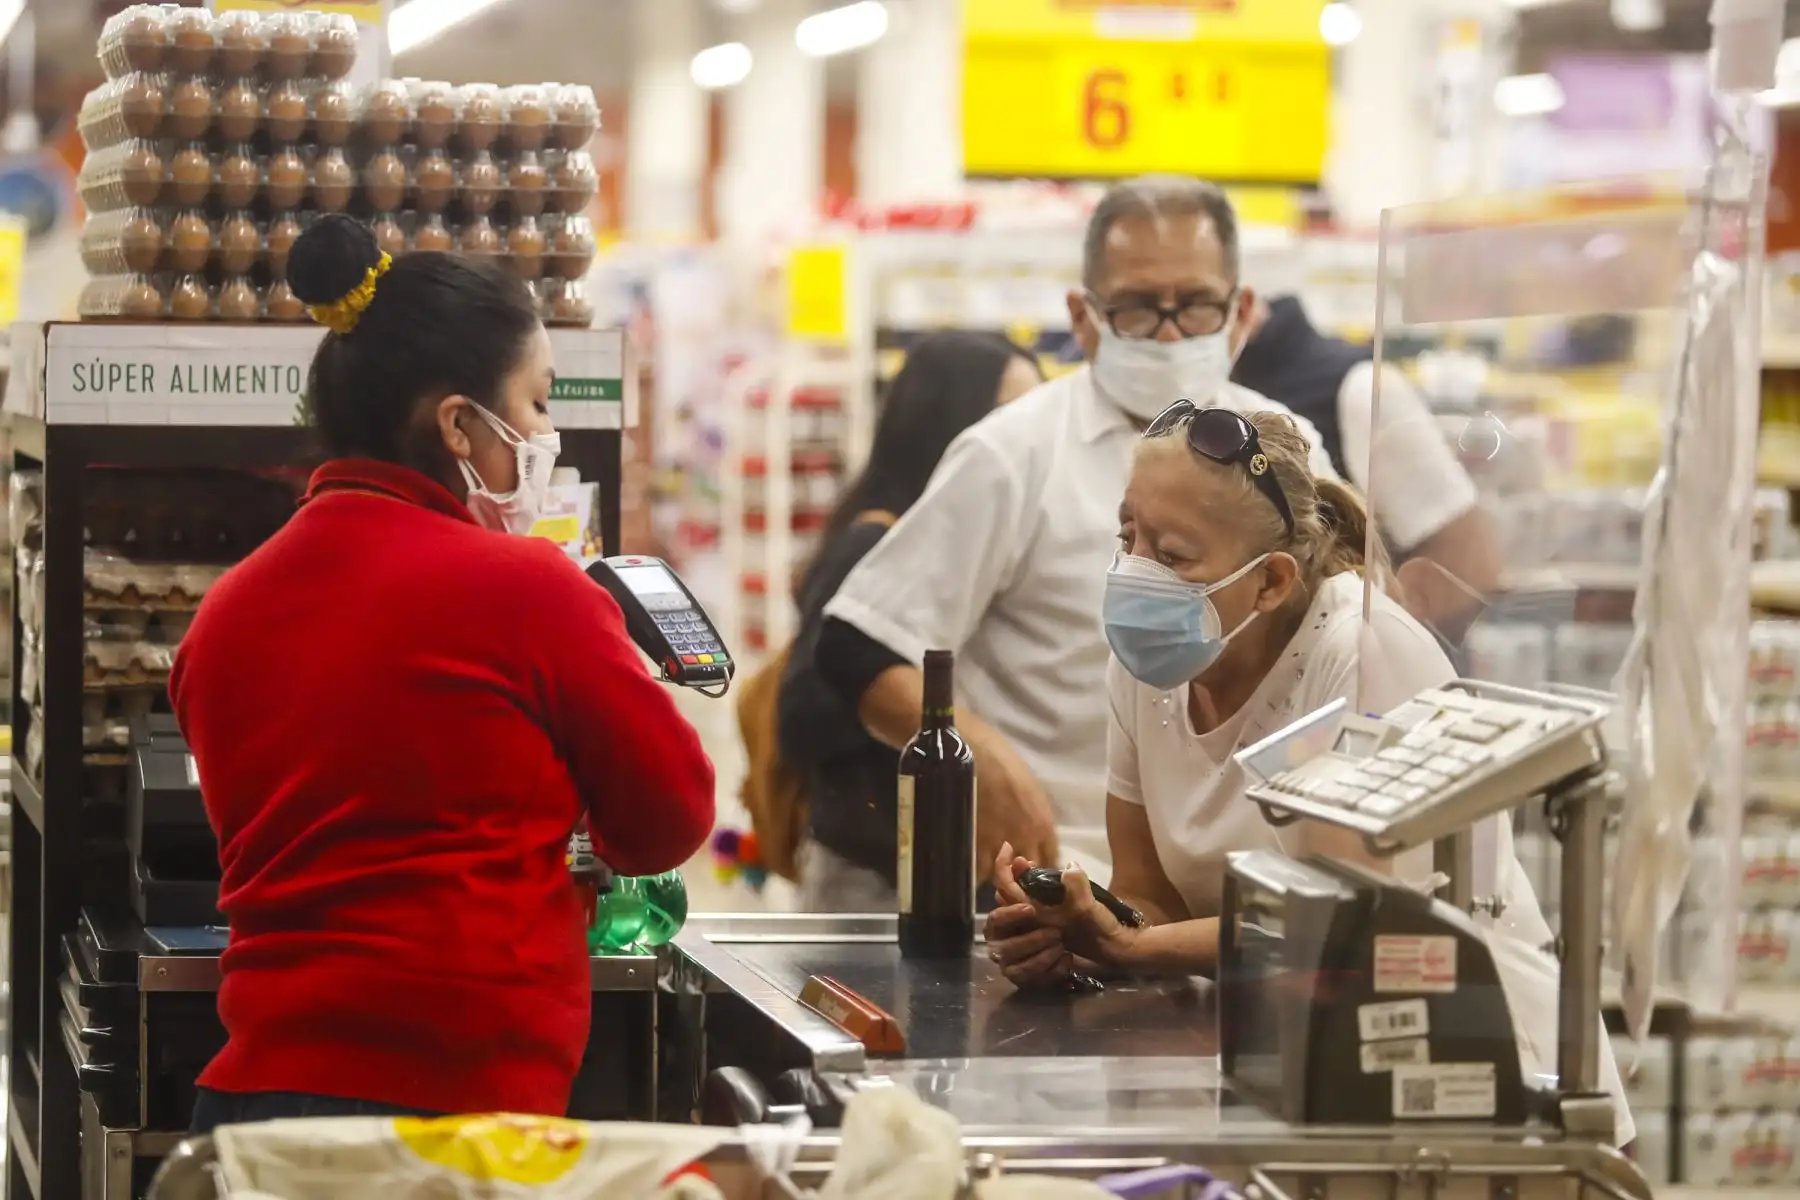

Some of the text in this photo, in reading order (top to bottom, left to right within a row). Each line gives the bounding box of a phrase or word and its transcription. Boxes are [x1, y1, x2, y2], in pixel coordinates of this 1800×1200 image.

[1082, 67, 1130, 150] 6
[72, 357, 301, 394] SÚPER ALIMENTO
